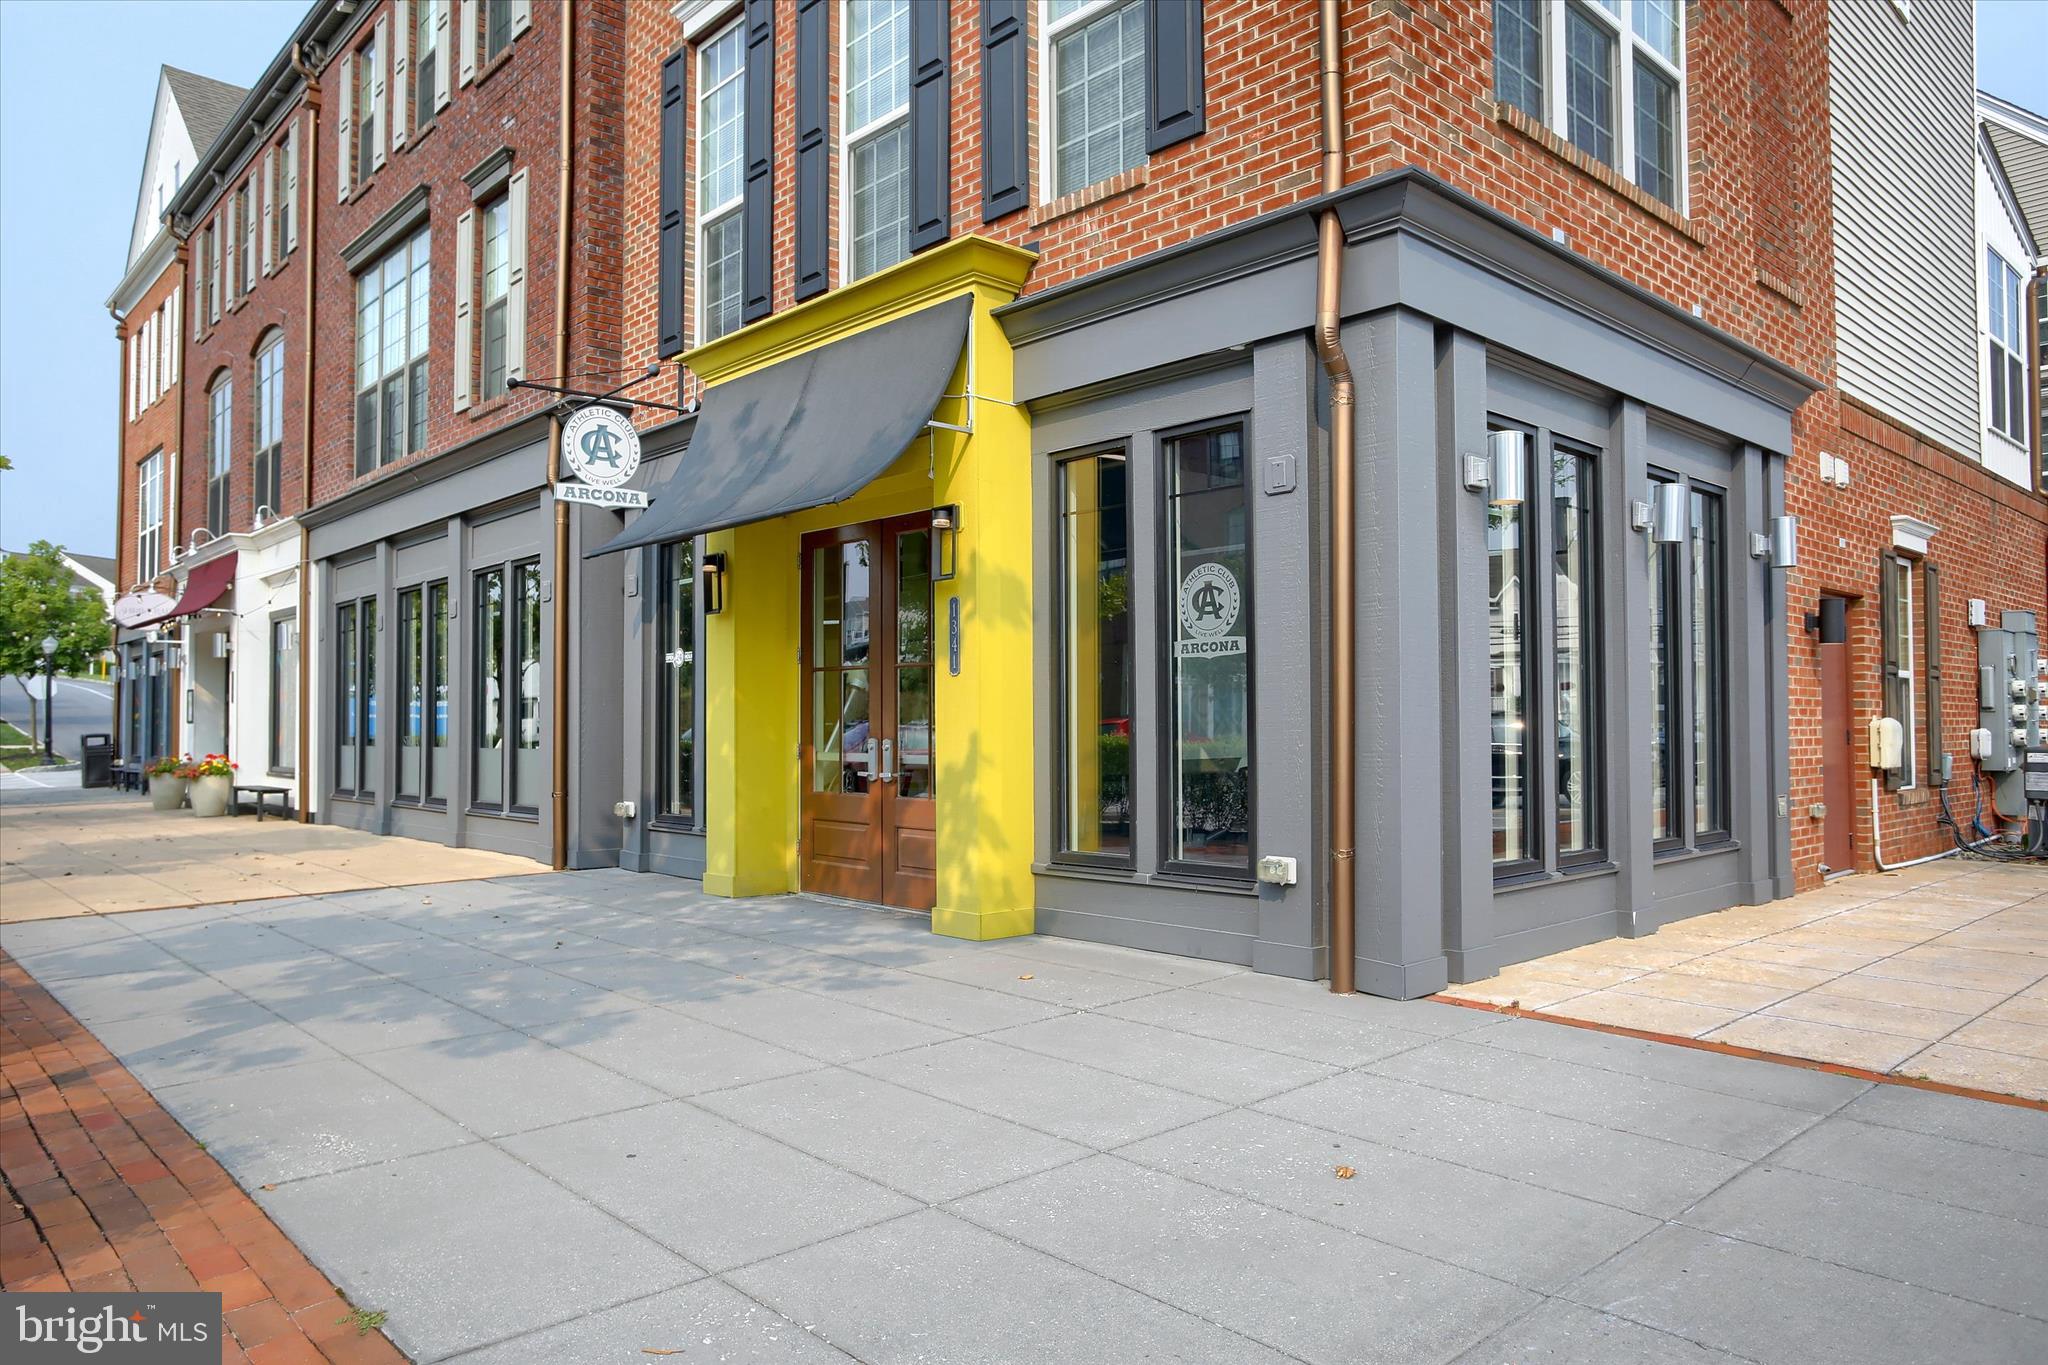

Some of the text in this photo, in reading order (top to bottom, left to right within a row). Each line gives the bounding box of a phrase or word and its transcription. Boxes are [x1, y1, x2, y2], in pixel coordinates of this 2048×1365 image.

[569, 408, 635, 440] ATHLETIC CLUB
[584, 474, 621, 486] LIVE WELL
[563, 486, 641, 505] ARCONA
[1183, 565, 1235, 594] ATHLETIC CLUB
[1195, 629, 1224, 638] LIVE WELL
[1180, 640, 1240, 654] ARCONA
